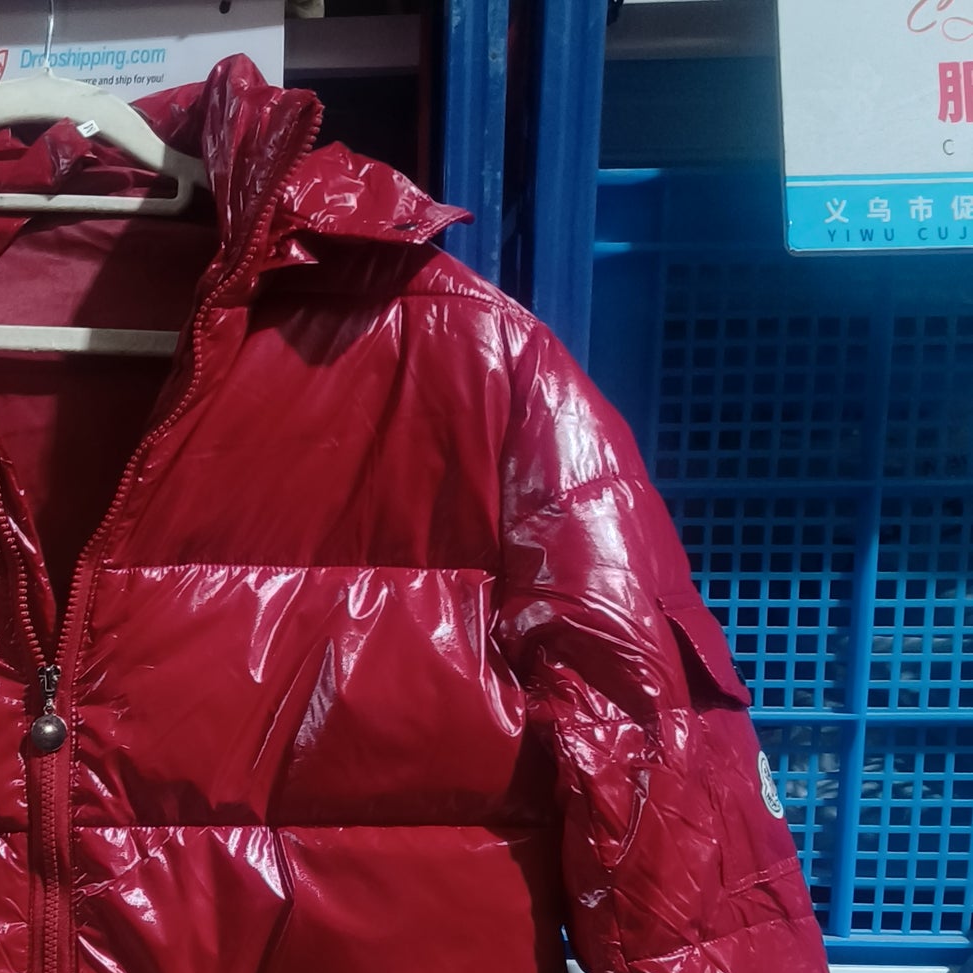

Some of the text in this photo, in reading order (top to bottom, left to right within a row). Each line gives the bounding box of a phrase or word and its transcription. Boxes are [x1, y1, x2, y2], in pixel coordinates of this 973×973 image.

[98, 75, 114, 86] and
[115, 74, 132, 87] ship
[133, 73, 145, 83] for
[146, 73, 165, 85] you!
[824, 195, 973, 223] 义乌市促
[827, 226, 968, 243] YIWU CUJ
